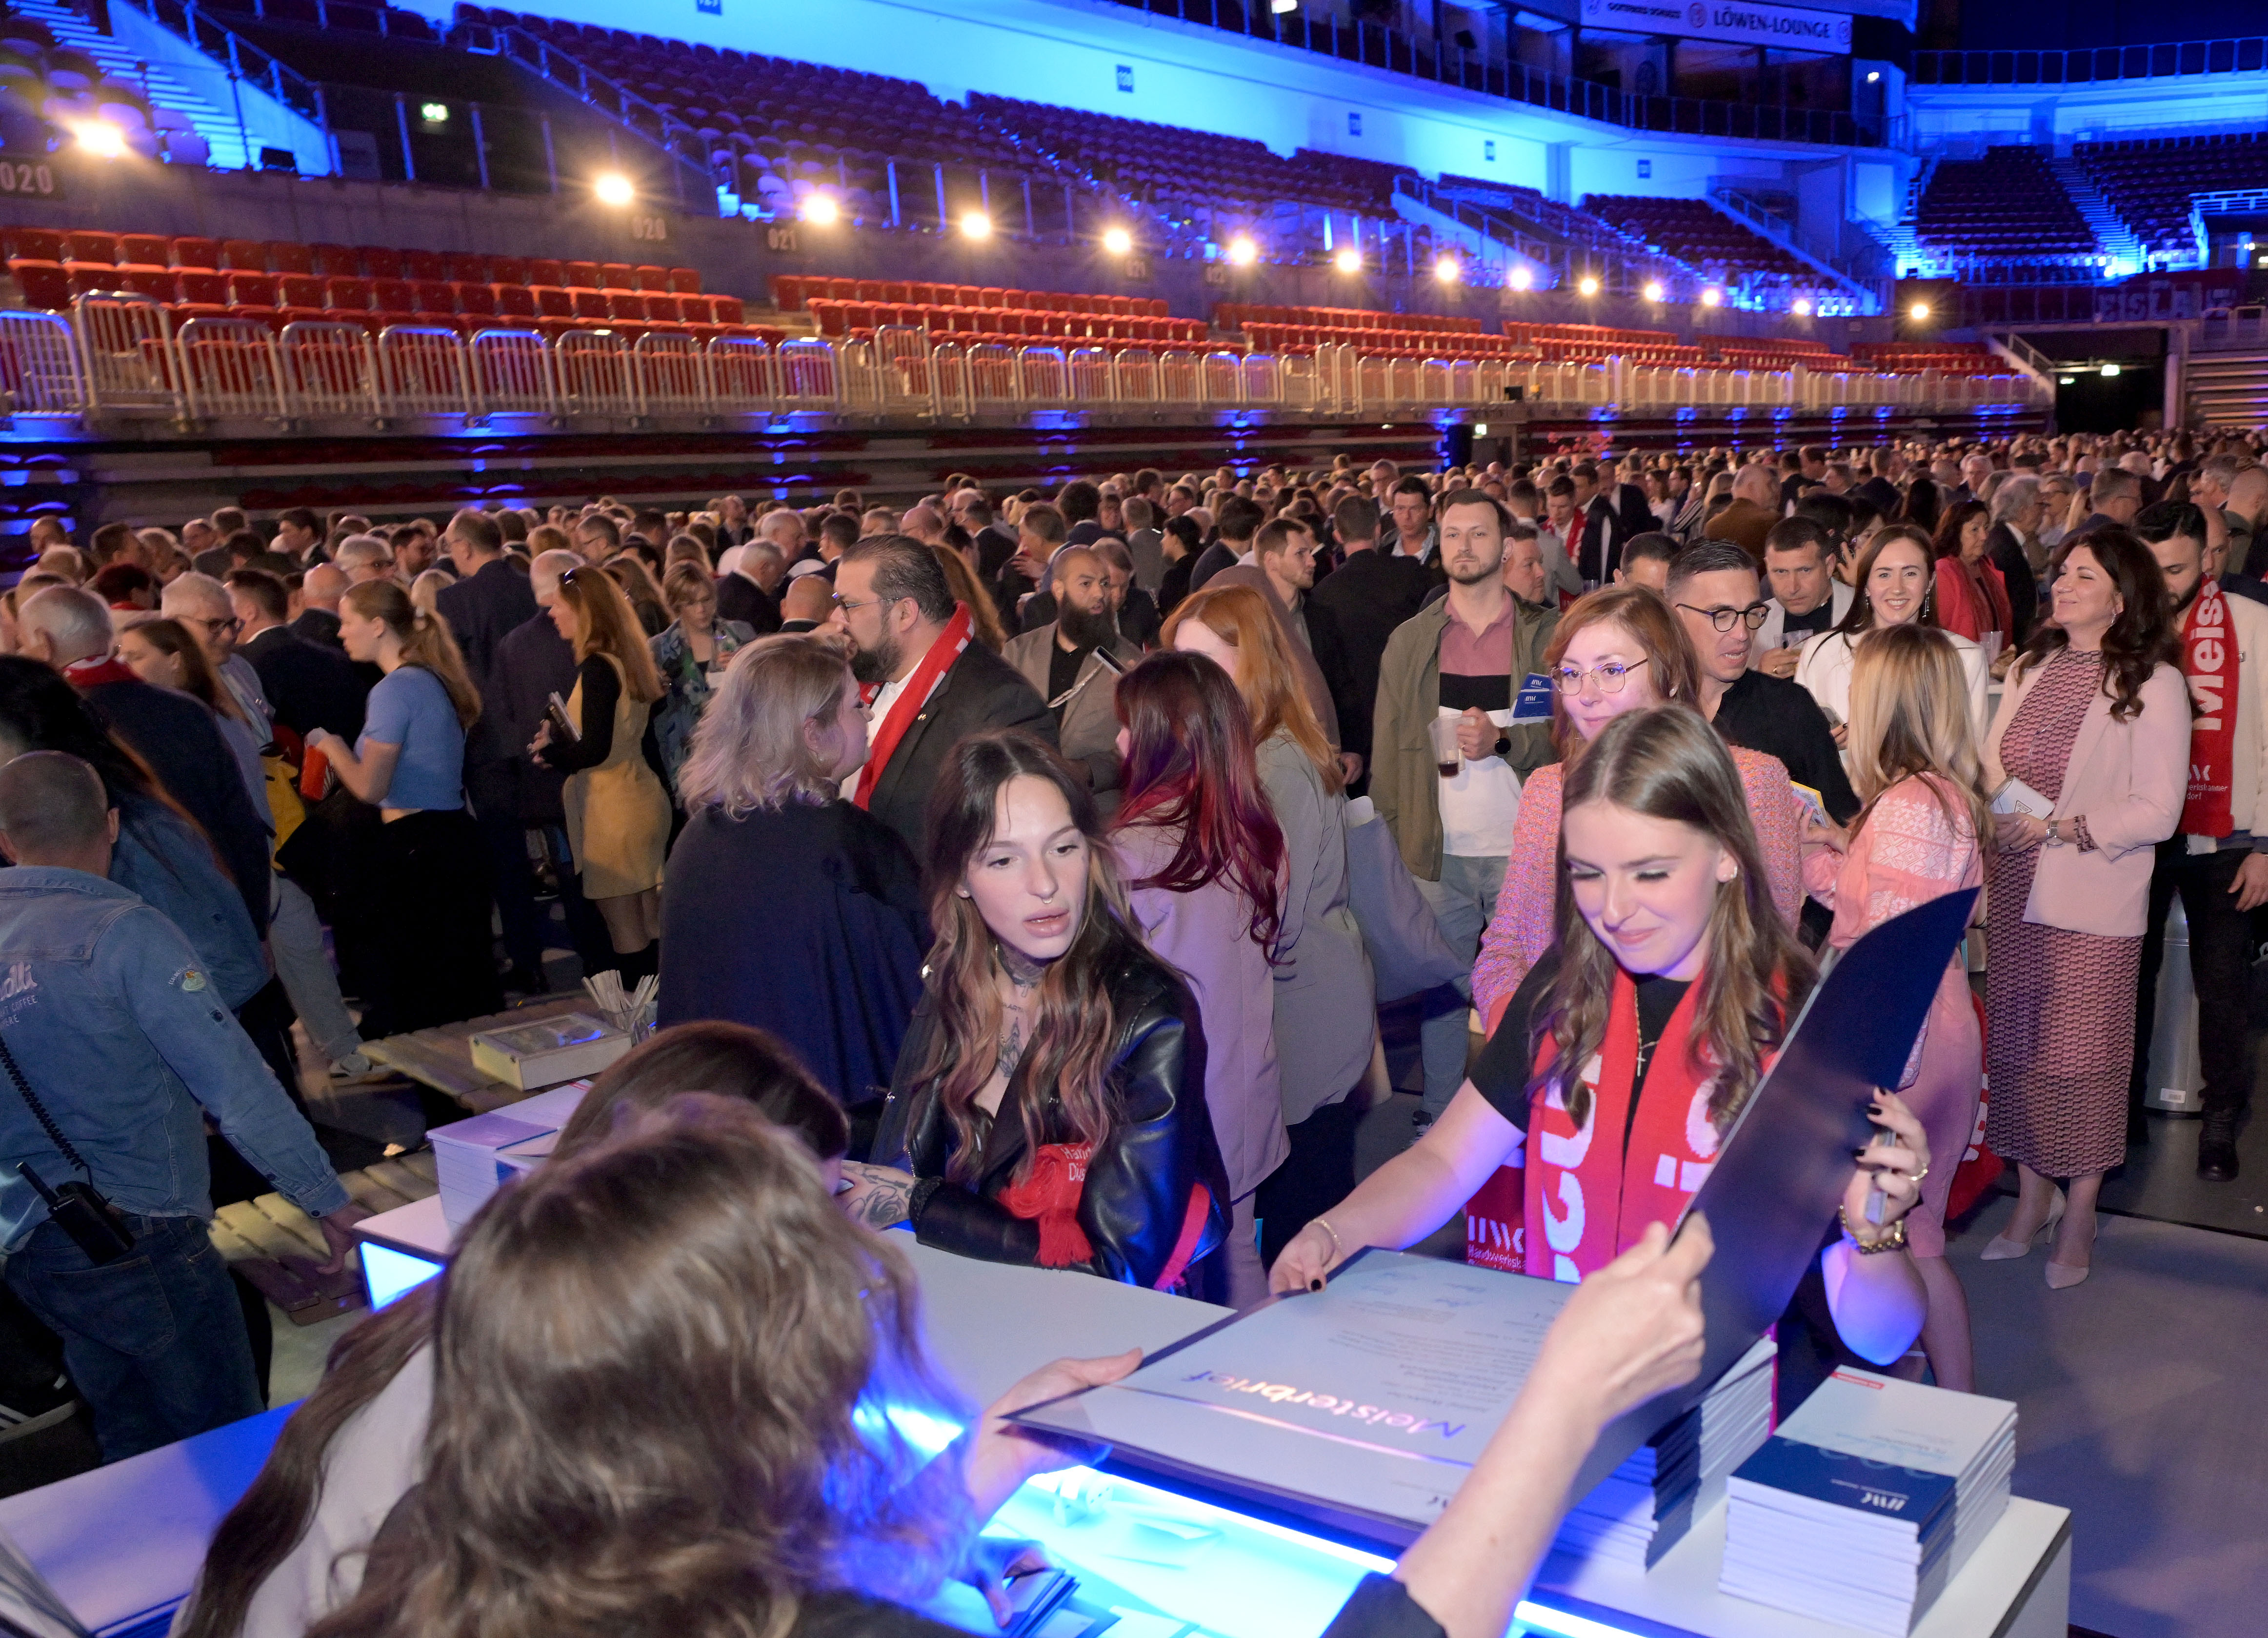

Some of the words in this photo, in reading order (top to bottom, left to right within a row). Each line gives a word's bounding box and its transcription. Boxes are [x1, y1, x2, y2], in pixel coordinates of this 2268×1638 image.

[1713, 6, 1830, 39] LÖWEN-LOUNGE
[2186, 791, 2202, 800] dorf
[11, 995, 39, 1012] COFFEE
[1181, 1369, 1466, 1440] Meisterbrief
